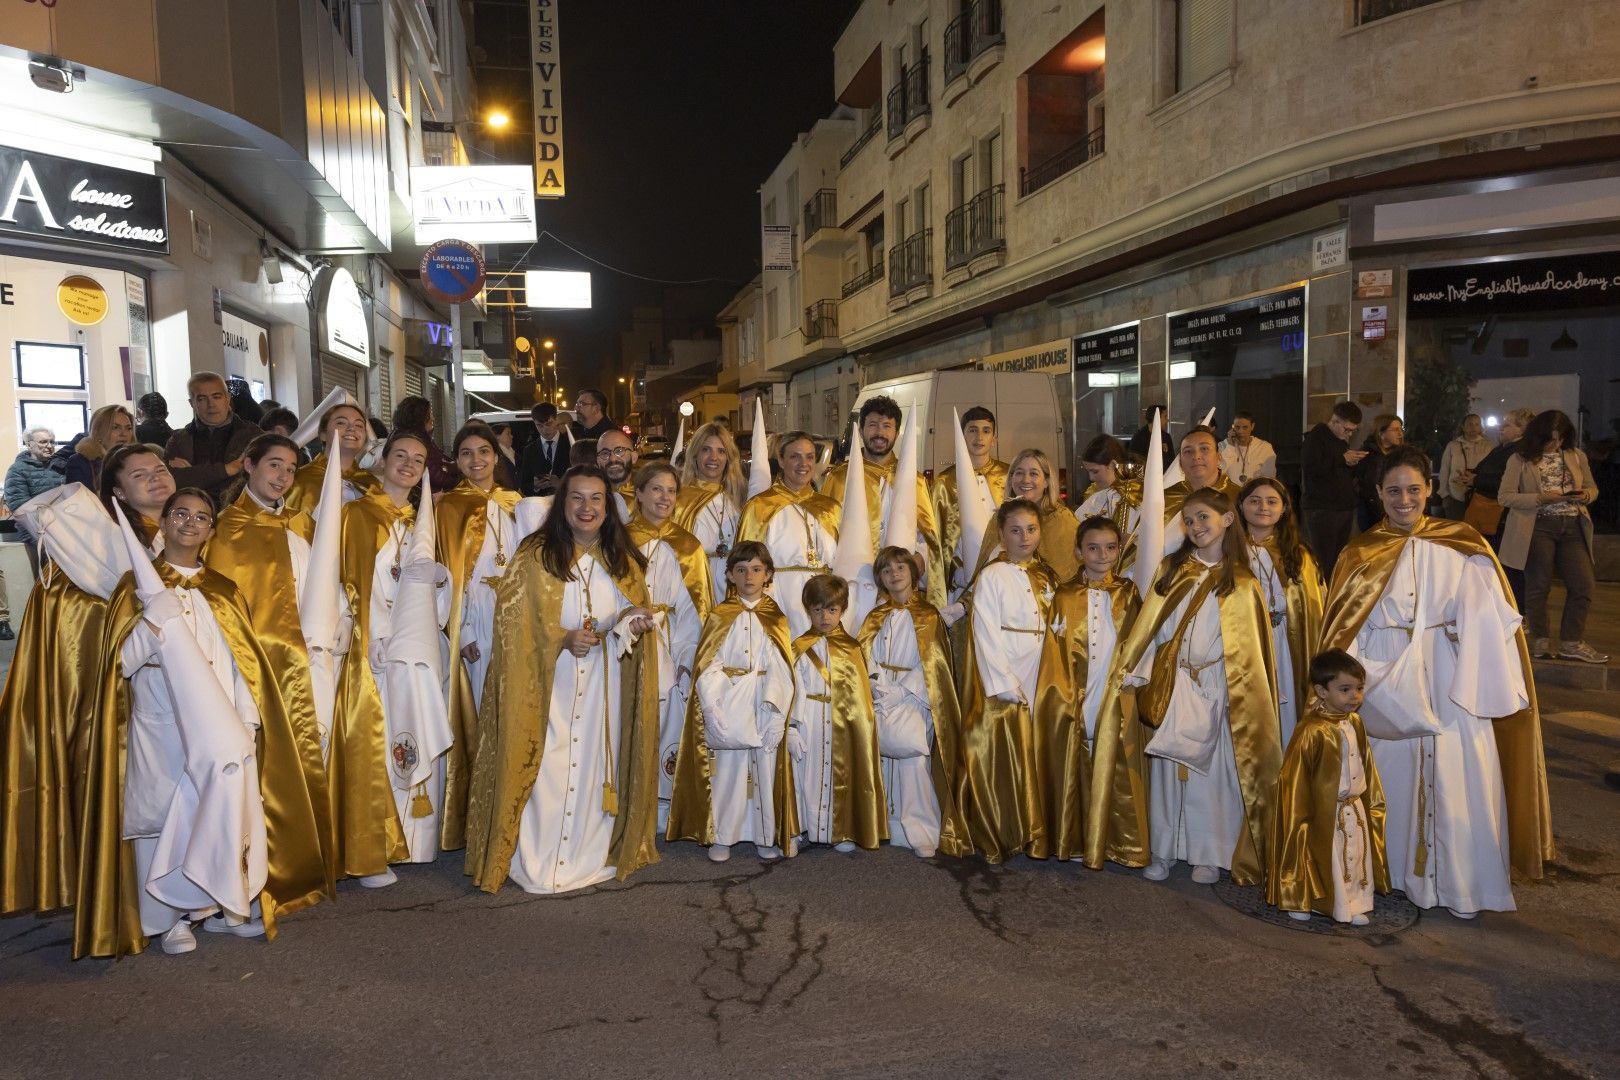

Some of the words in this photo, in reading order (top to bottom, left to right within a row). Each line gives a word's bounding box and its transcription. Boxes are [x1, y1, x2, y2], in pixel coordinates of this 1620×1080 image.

[536, 62, 562, 188] VIUDA
[0, 160, 64, 229] A
[70, 178, 133, 208] home
[67, 212, 166, 243] solutions
[421, 246, 436, 273] EXCEPTO
[436, 240, 459, 248] CARGA
[466, 244, 486, 277] DESCARGA
[432, 255, 475, 263] LABORABLES
[0, 283, 14, 305] E
[1005, 355, 1037, 372] ENGLISH
[1038, 348, 1068, 368] HOUSE
